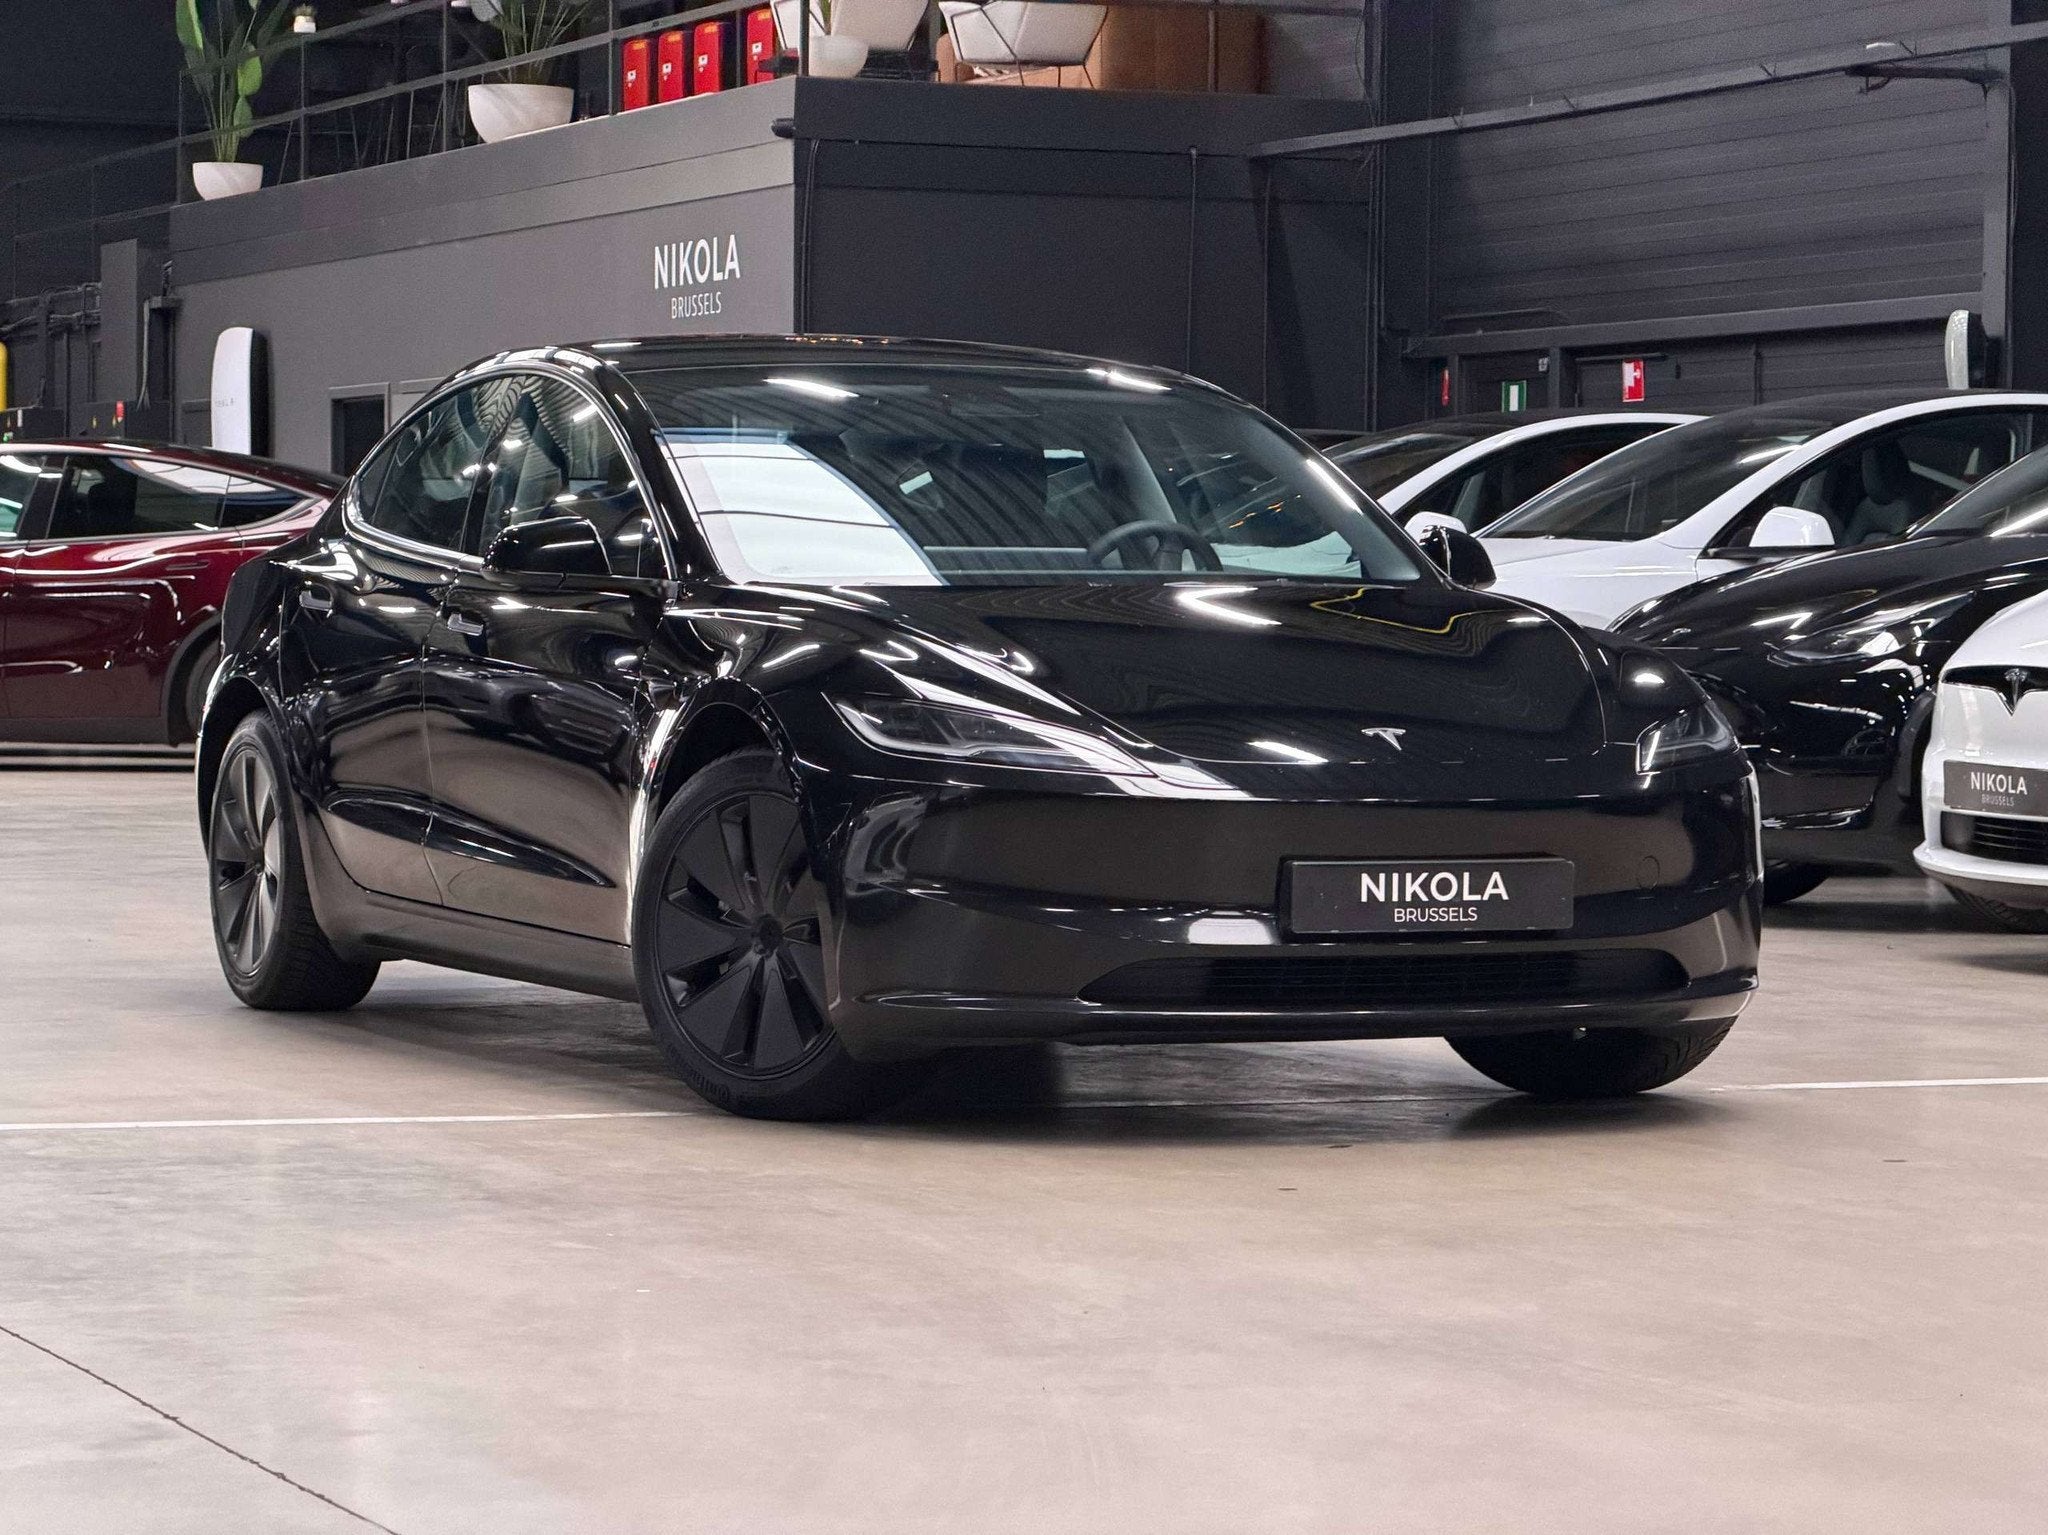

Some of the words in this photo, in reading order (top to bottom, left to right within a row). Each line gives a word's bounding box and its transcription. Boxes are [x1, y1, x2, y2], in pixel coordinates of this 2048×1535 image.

[654, 234, 741, 290] NIKOLA
[671, 291, 722, 319] BRUSSELS
[1970, 771, 2028, 795] NIKOLA
[1360, 871, 1510, 903] NIKOLA
[1393, 906, 1478, 923] BRUSSELS
